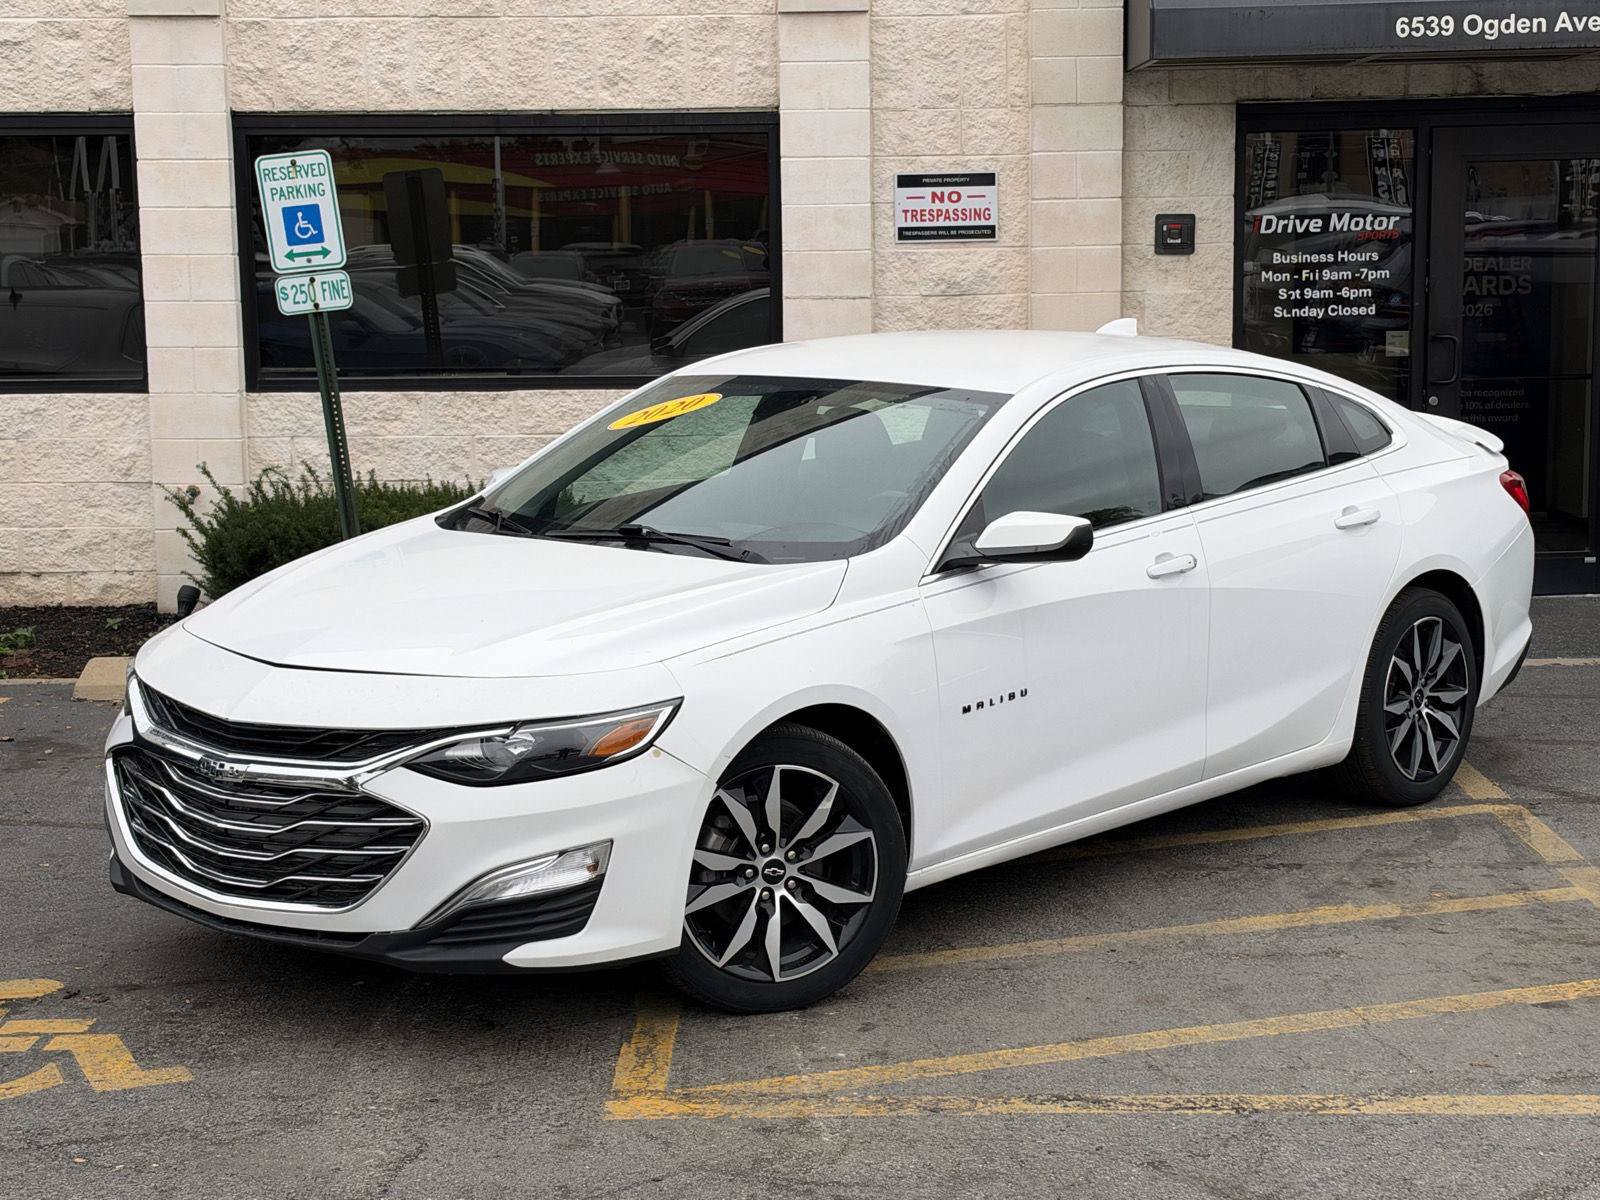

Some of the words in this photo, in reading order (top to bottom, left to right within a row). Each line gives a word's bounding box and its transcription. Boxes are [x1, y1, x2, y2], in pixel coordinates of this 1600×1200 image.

[1395, 15, 1455, 38] 6539
[1463, 13, 1547, 40] Ogden
[1553, 11, 1600, 33] Ave
[262, 162, 327, 183] RESERVED
[270, 183, 326, 202] PARKING
[930, 190, 962, 204] NO
[902, 207, 992, 223] TRESPASSING
[1252, 214, 1323, 234] iDrive
[1329, 212, 1400, 232] Motor
[1356, 229, 1401, 241] SPORTS
[1272, 251, 1335, 264] Business
[1337, 250, 1379, 262] Hours
[1463, 255, 1532, 272] DEALER
[1261, 270, 1291, 282] Mon
[1322, 269, 1352, 280] 9am
[280, 281, 317, 305] $250
[321, 279, 349, 302] FINE
[1304, 287, 1334, 299] 9am
[1273, 305, 1325, 319] Sunday
[1327, 303, 1376, 316] Closed
[622, 396, 706, 426] 2020
[962, 688, 1028, 714] MALIBU
